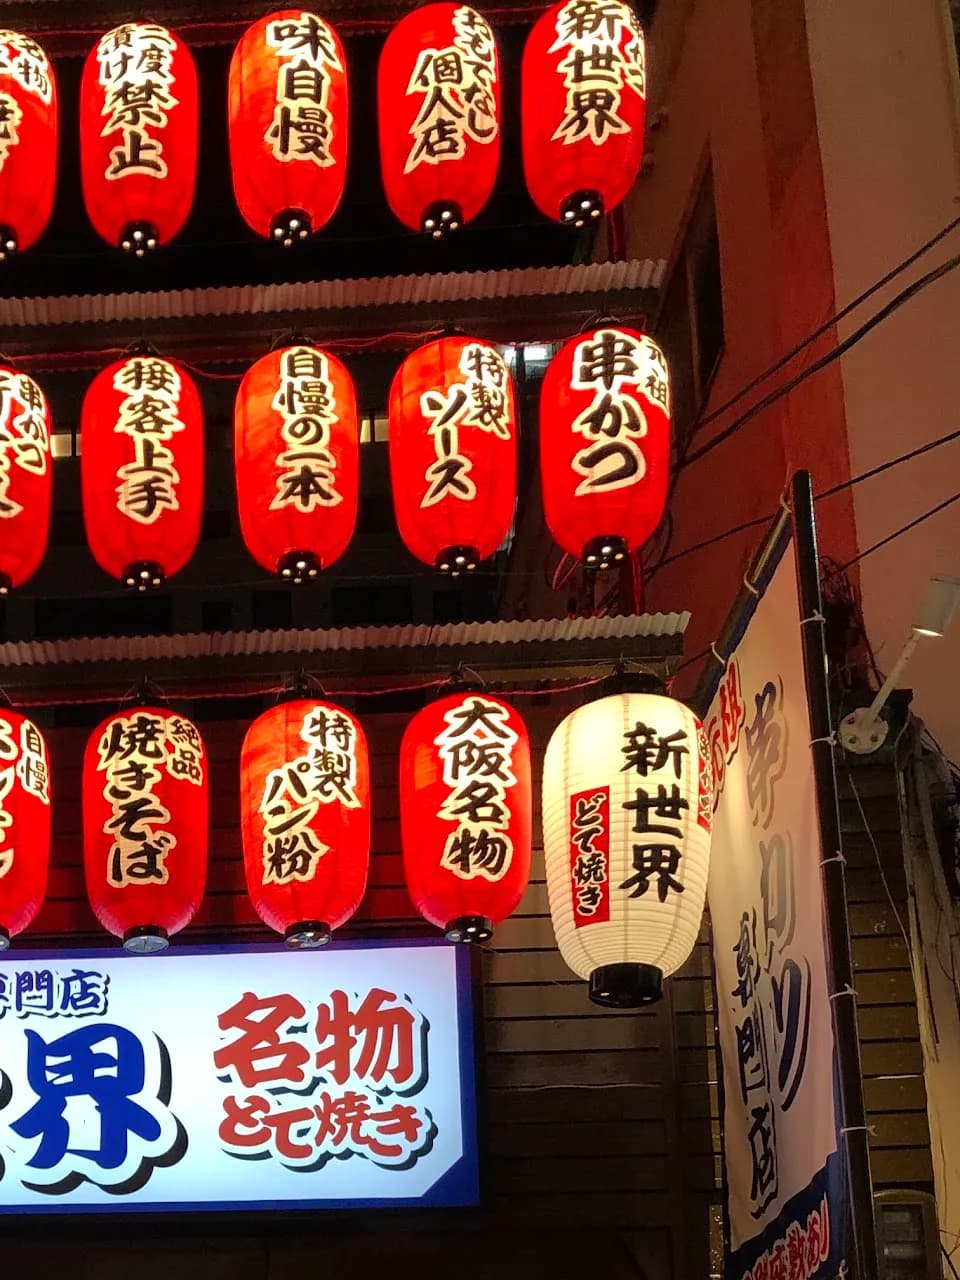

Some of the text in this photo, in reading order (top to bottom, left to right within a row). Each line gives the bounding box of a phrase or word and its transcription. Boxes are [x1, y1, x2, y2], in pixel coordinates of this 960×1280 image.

[138, 26, 172, 79] 二度
[270, 16, 338, 161] 味自慢
[413, 51, 465, 161] 個人店
[560, 0, 624, 139] 新世界
[106, 78, 171, 176] 禁止
[16, 378, 47, 470] 串かつ
[121, 360, 176, 519] 接客上手
[278, 349, 335, 507] 自慢の一本
[425, 389, 470, 499] ソース
[466, 346, 509, 436] 特製
[577, 331, 641, 488] 串かつ
[20, 723, 50, 801] 自慢
[101, 716, 172, 883] 焼きそば
[169, 717, 203, 784] 絶品
[308, 709, 356, 804] 特製
[445, 700, 511, 876] 大阪名物
[265, 761, 319, 878] パン粉
[574, 791, 608, 917] どて焼き
[618, 720, 690, 903] 新世界
[212, 986, 420, 1090] 名物
